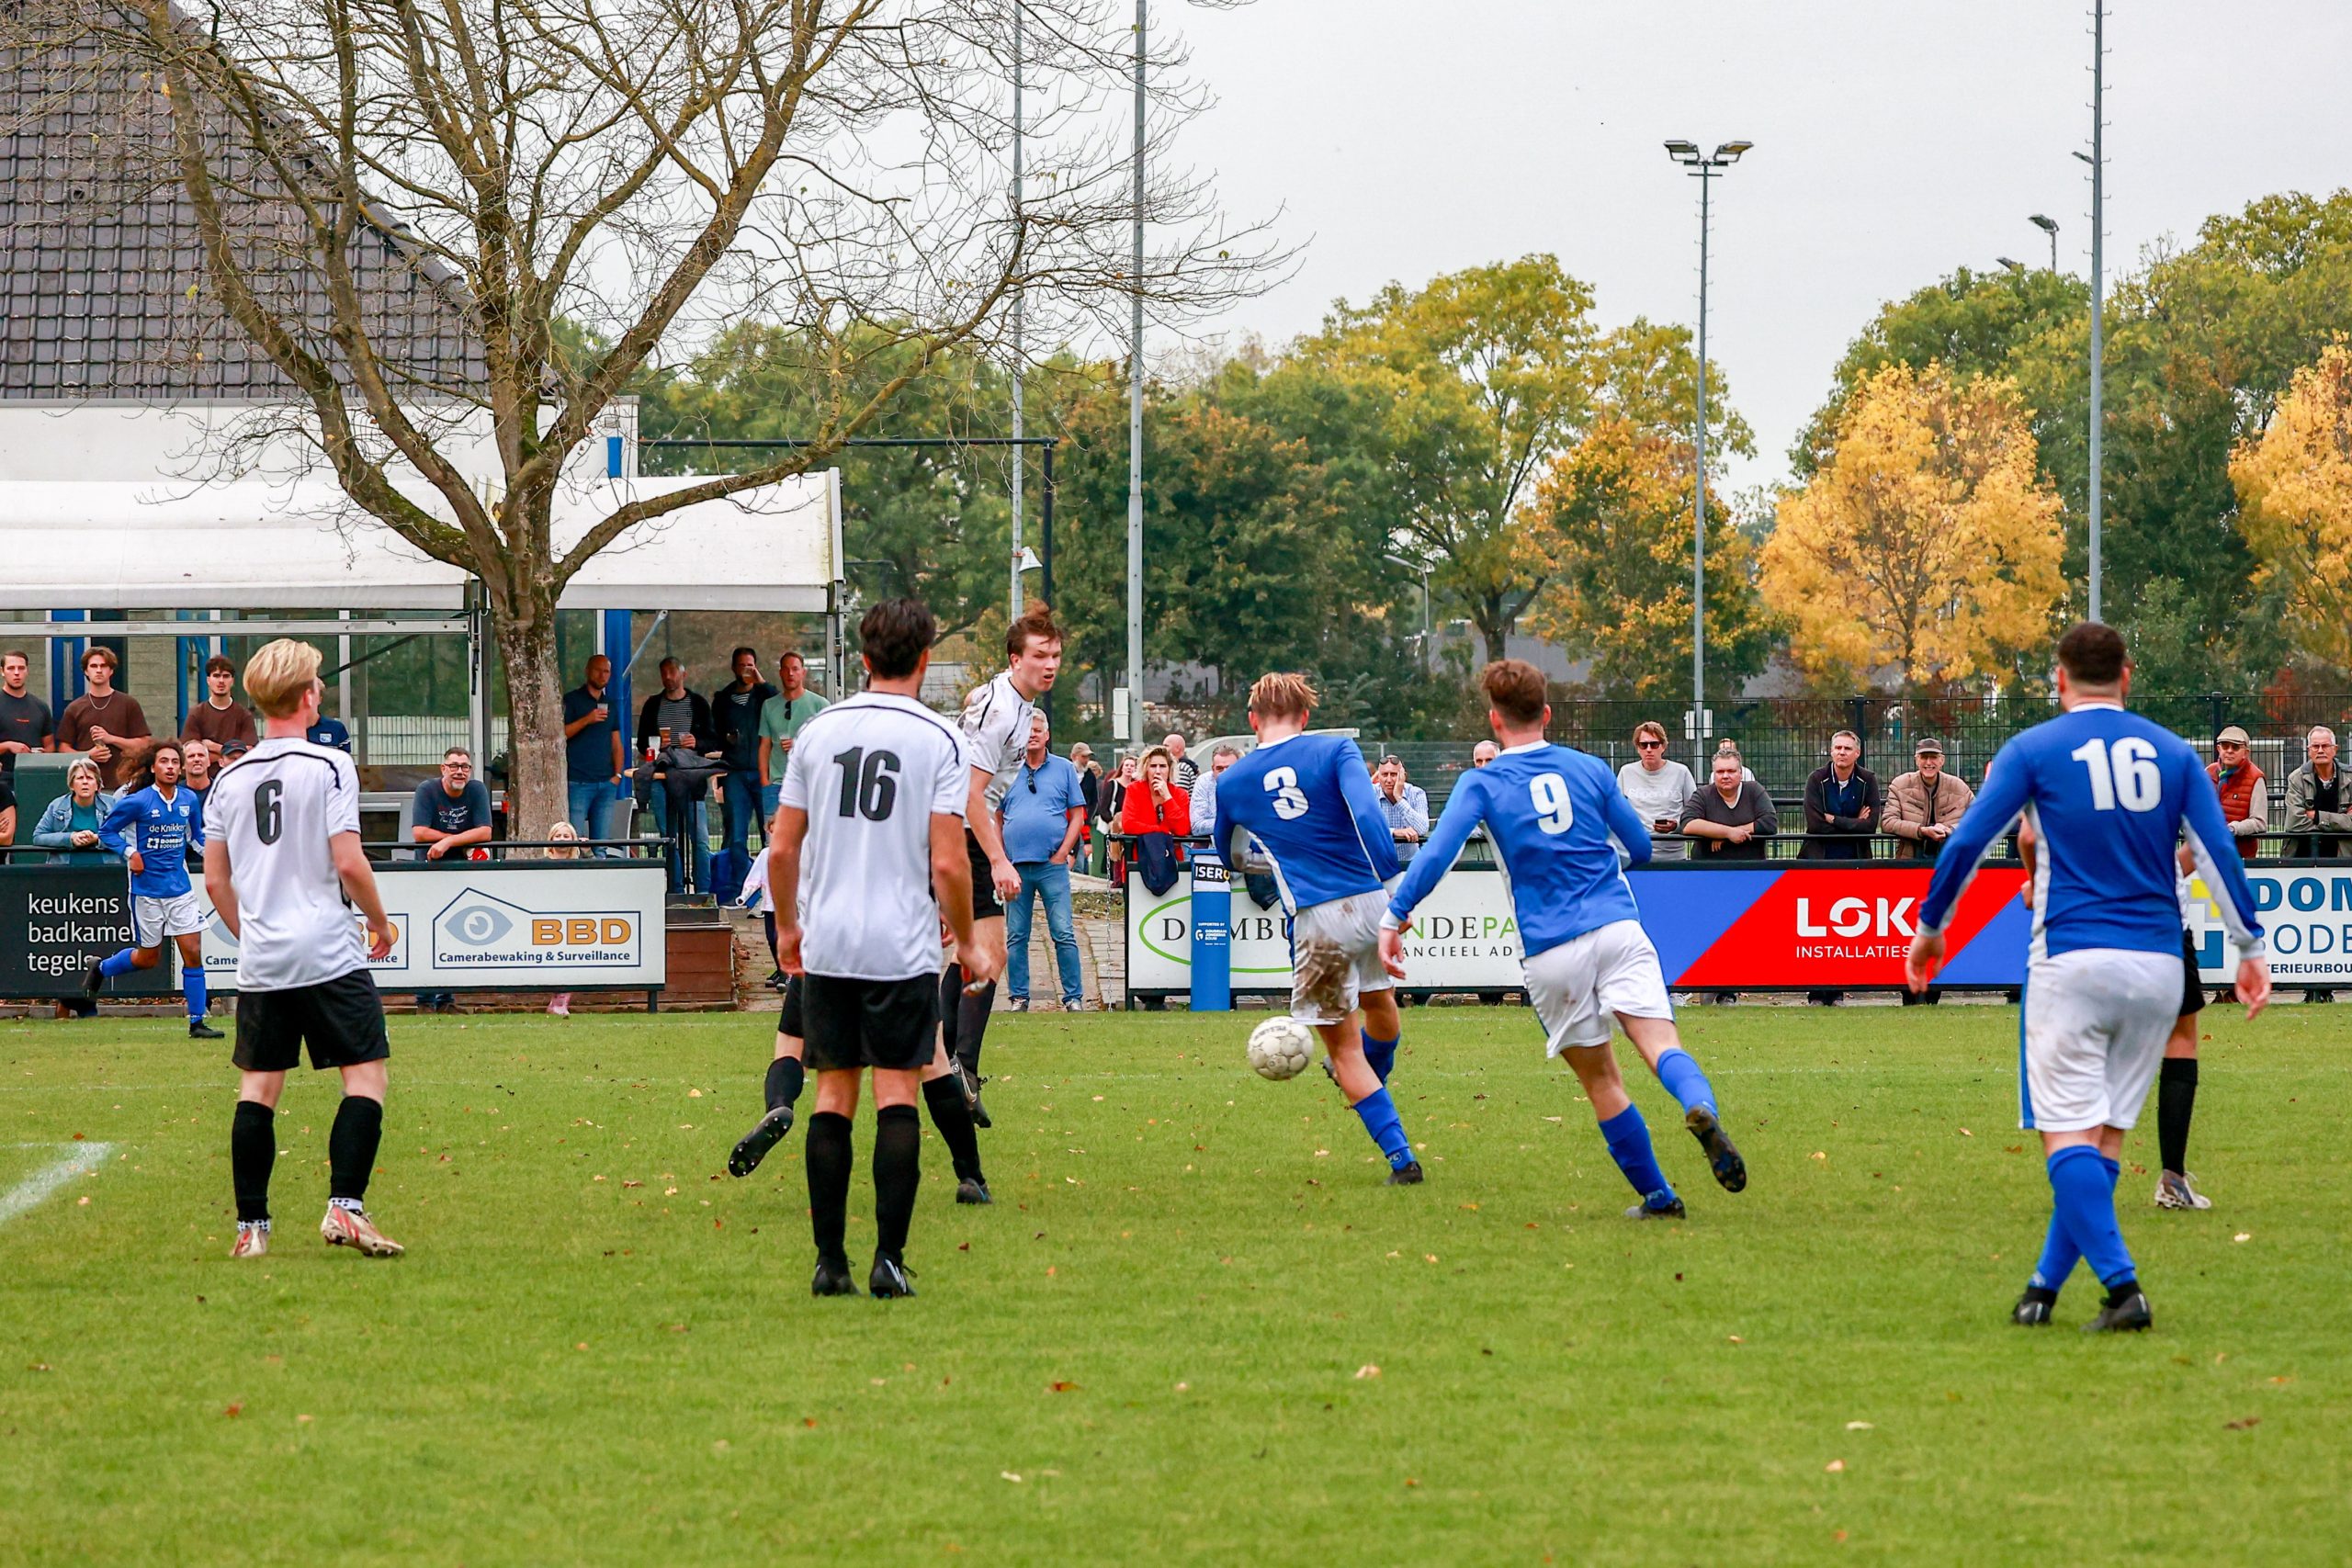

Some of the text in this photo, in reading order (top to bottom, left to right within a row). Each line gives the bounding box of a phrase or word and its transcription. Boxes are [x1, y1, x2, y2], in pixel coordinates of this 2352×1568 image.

[833, 746, 900, 821] 16
[2071, 737, 2161, 812] 16
[1263, 766, 1308, 820] 3
[1530, 773, 1573, 834] 9
[254, 780, 283, 845] 6
[1195, 865, 1230, 880] ISERO
[28, 893, 120, 915] keukens
[1797, 897, 1917, 937] LOK
[532, 919, 632, 945] BBD
[205, 955, 238, 965] Came
[439, 950, 631, 964] Camerabewaking & Surveillance
[1402, 946, 1513, 957] ANCIEEL AD
[1796, 945, 1911, 958] INSTALLATIES
[2267, 964, 2352, 974] ERIEURBOU
